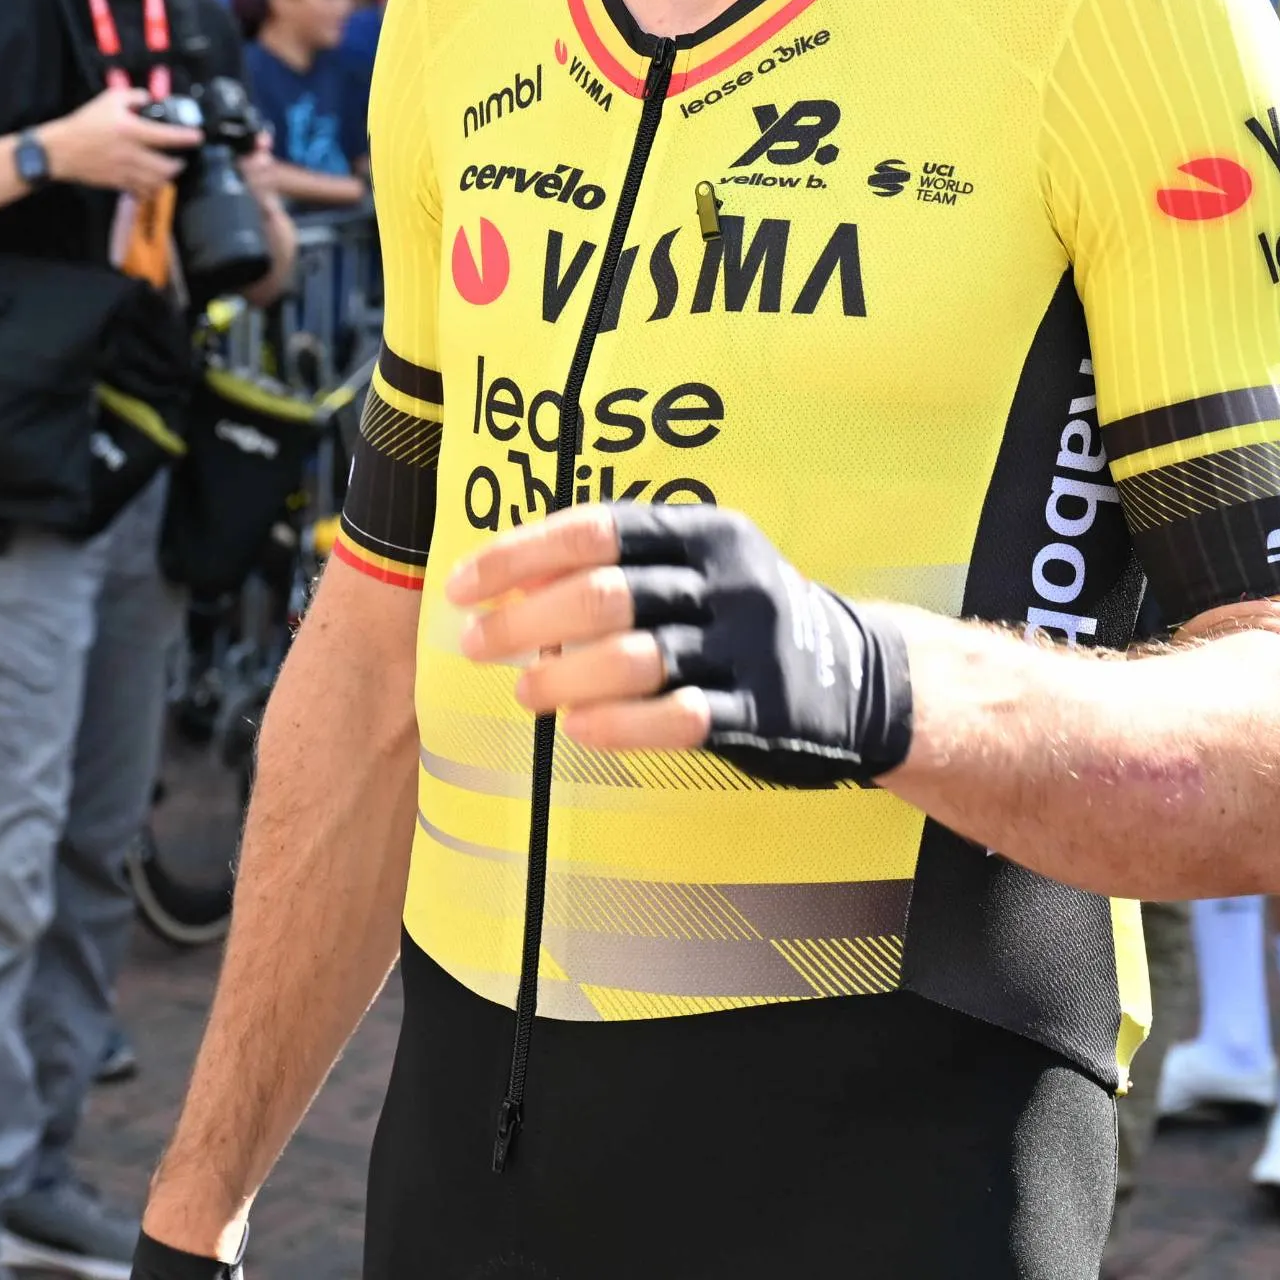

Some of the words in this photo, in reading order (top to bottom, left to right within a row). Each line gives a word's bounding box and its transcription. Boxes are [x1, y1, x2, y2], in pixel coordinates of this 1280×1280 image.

[463, 64, 543, 139] nimbl
[569, 56, 614, 113] VISMA
[679, 71, 755, 119] lease
[459, 163, 607, 211] cervélo
[715, 173, 802, 189] yellow
[805, 174, 828, 189] b.
[919, 175, 975, 195] WORLD
[923, 161, 956, 178] UCI
[915, 189, 959, 207] TEAM
[541, 215, 868, 334] VISMA
[473, 355, 725, 455] lease
